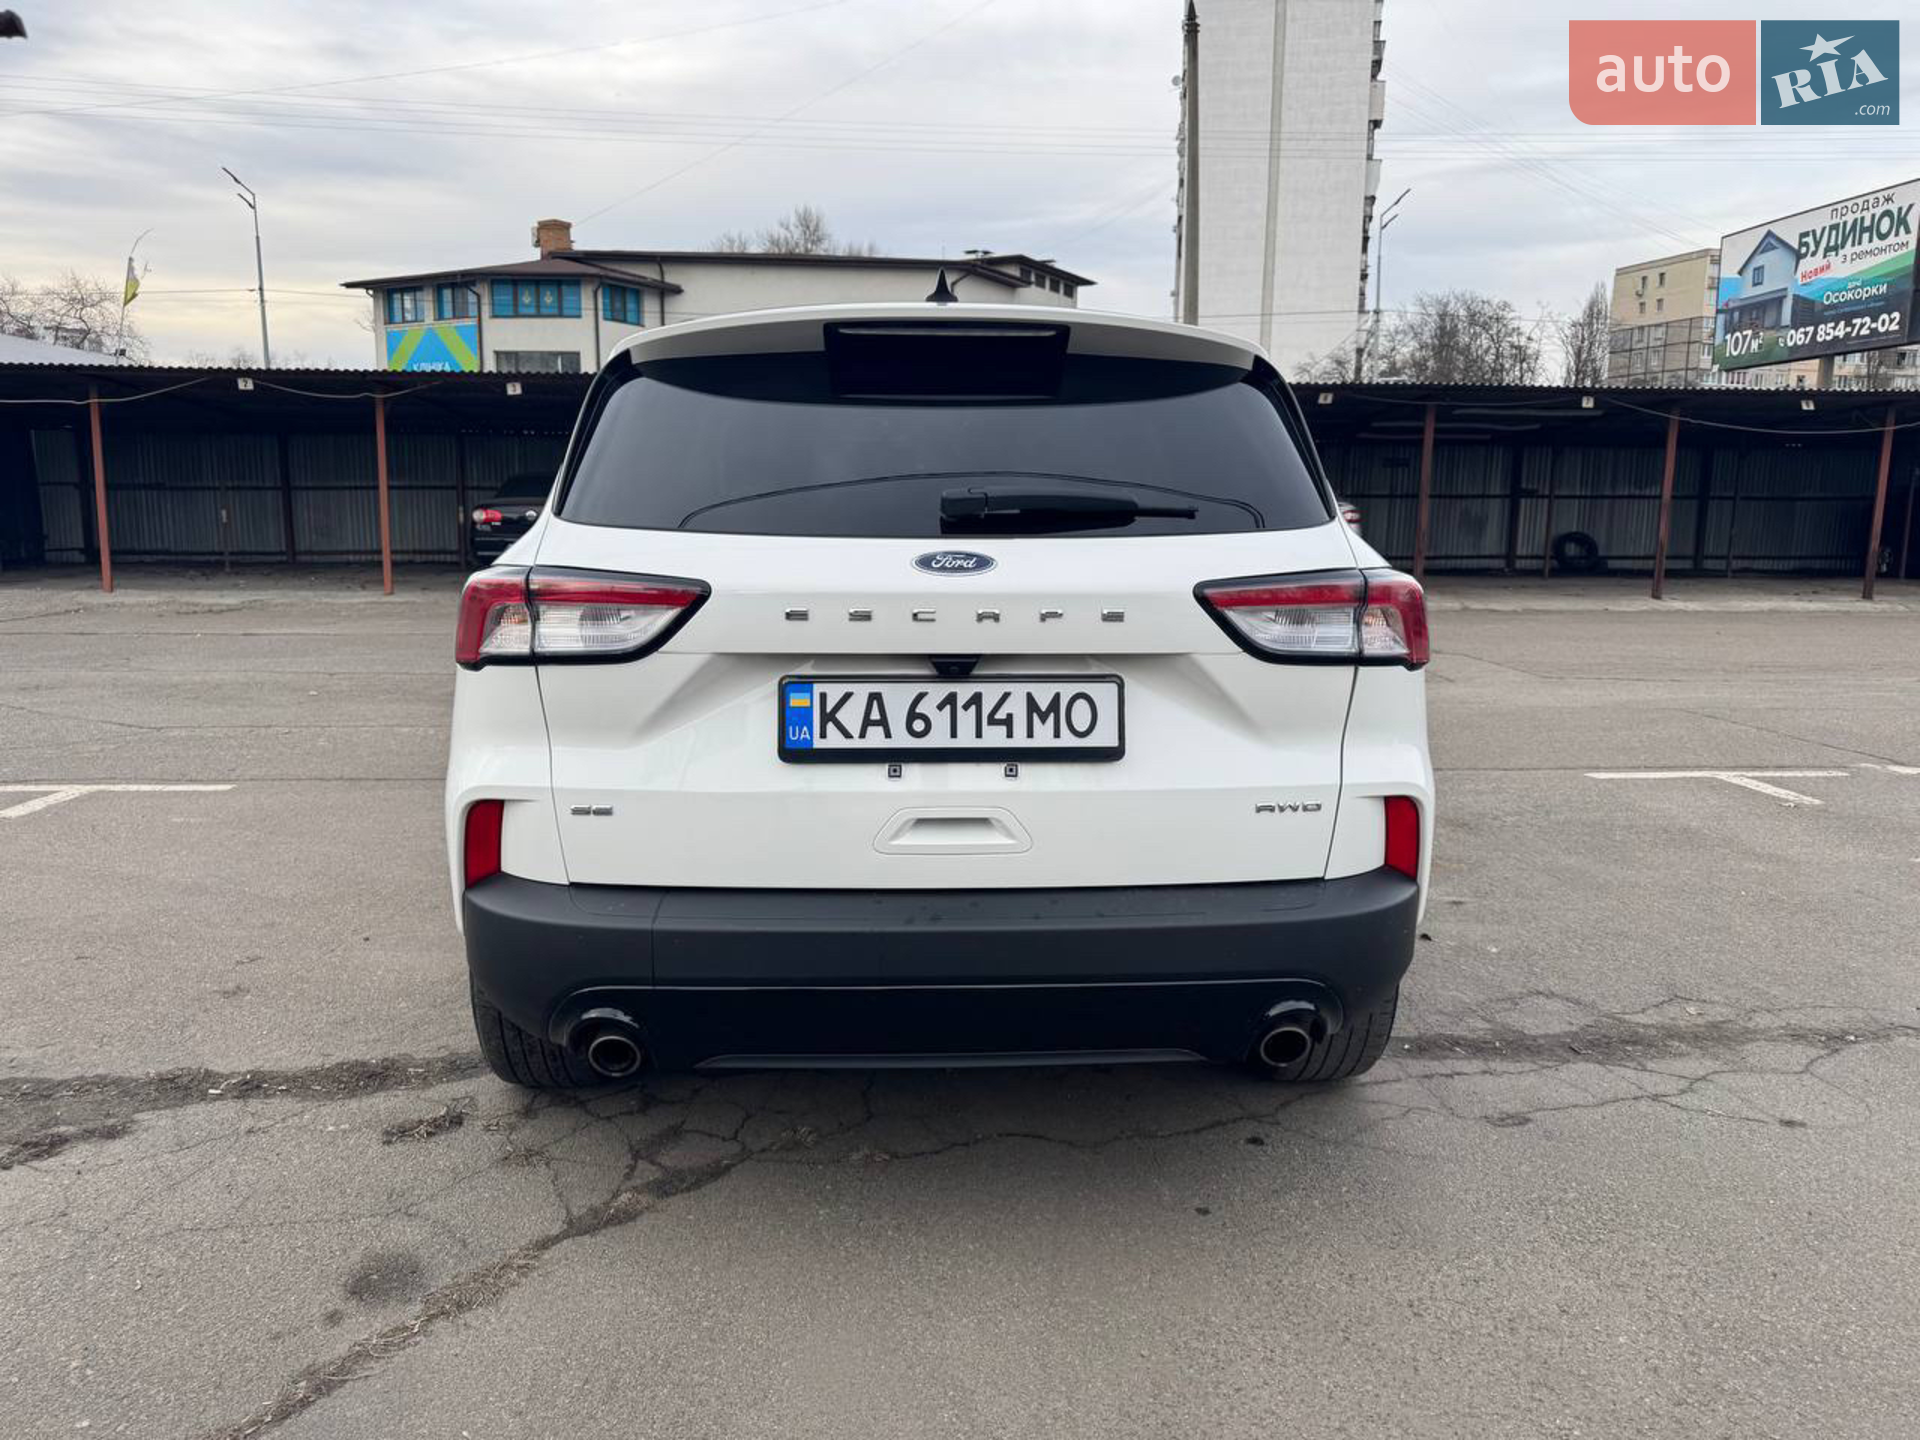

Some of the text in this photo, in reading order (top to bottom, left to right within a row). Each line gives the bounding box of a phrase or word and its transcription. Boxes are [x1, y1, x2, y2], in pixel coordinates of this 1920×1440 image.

[1830, 192, 1896, 220] продаж
[1798, 203, 1915, 260] БУДИНОК
[1850, 240, 1909, 264] ремонтом
[1823, 283, 1888, 305] Осокорки
[1787, 326, 1814, 347] 067
[1816, 311, 1901, 342] 854-72-02
[931, 554, 978, 570] Ford
[785, 608, 1125, 623] ESCAPE
[819, 691, 1098, 739] KA 6114 MO
[789, 725, 811, 742] UA
[570, 804, 613, 816] SE
[1255, 801, 1322, 813] AWD
